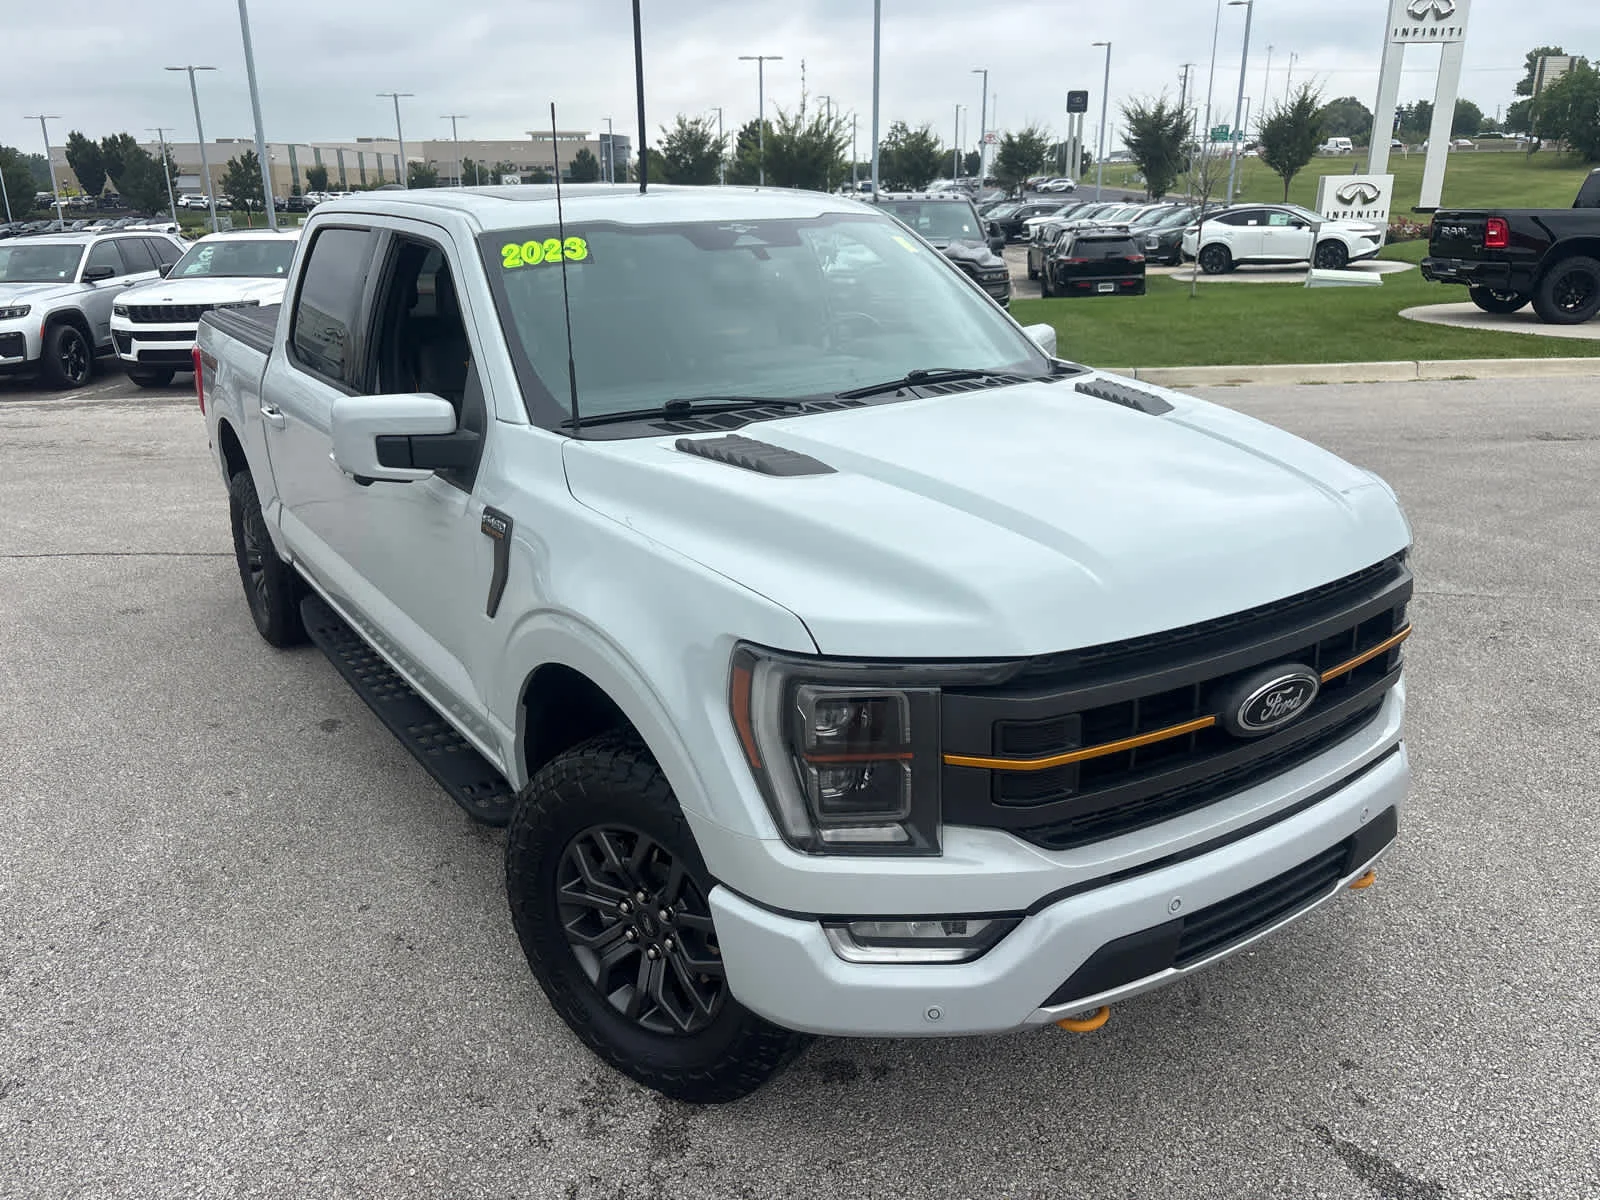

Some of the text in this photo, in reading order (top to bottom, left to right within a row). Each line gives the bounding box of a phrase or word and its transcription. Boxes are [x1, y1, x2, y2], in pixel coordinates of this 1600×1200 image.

[1393, 27, 1463, 37] INFINITI
[1326, 210, 1385, 219] INFINITI
[1441, 226, 1467, 235] RAM
[501, 237, 588, 268] 2023
[1260, 686, 1304, 721] Ford
